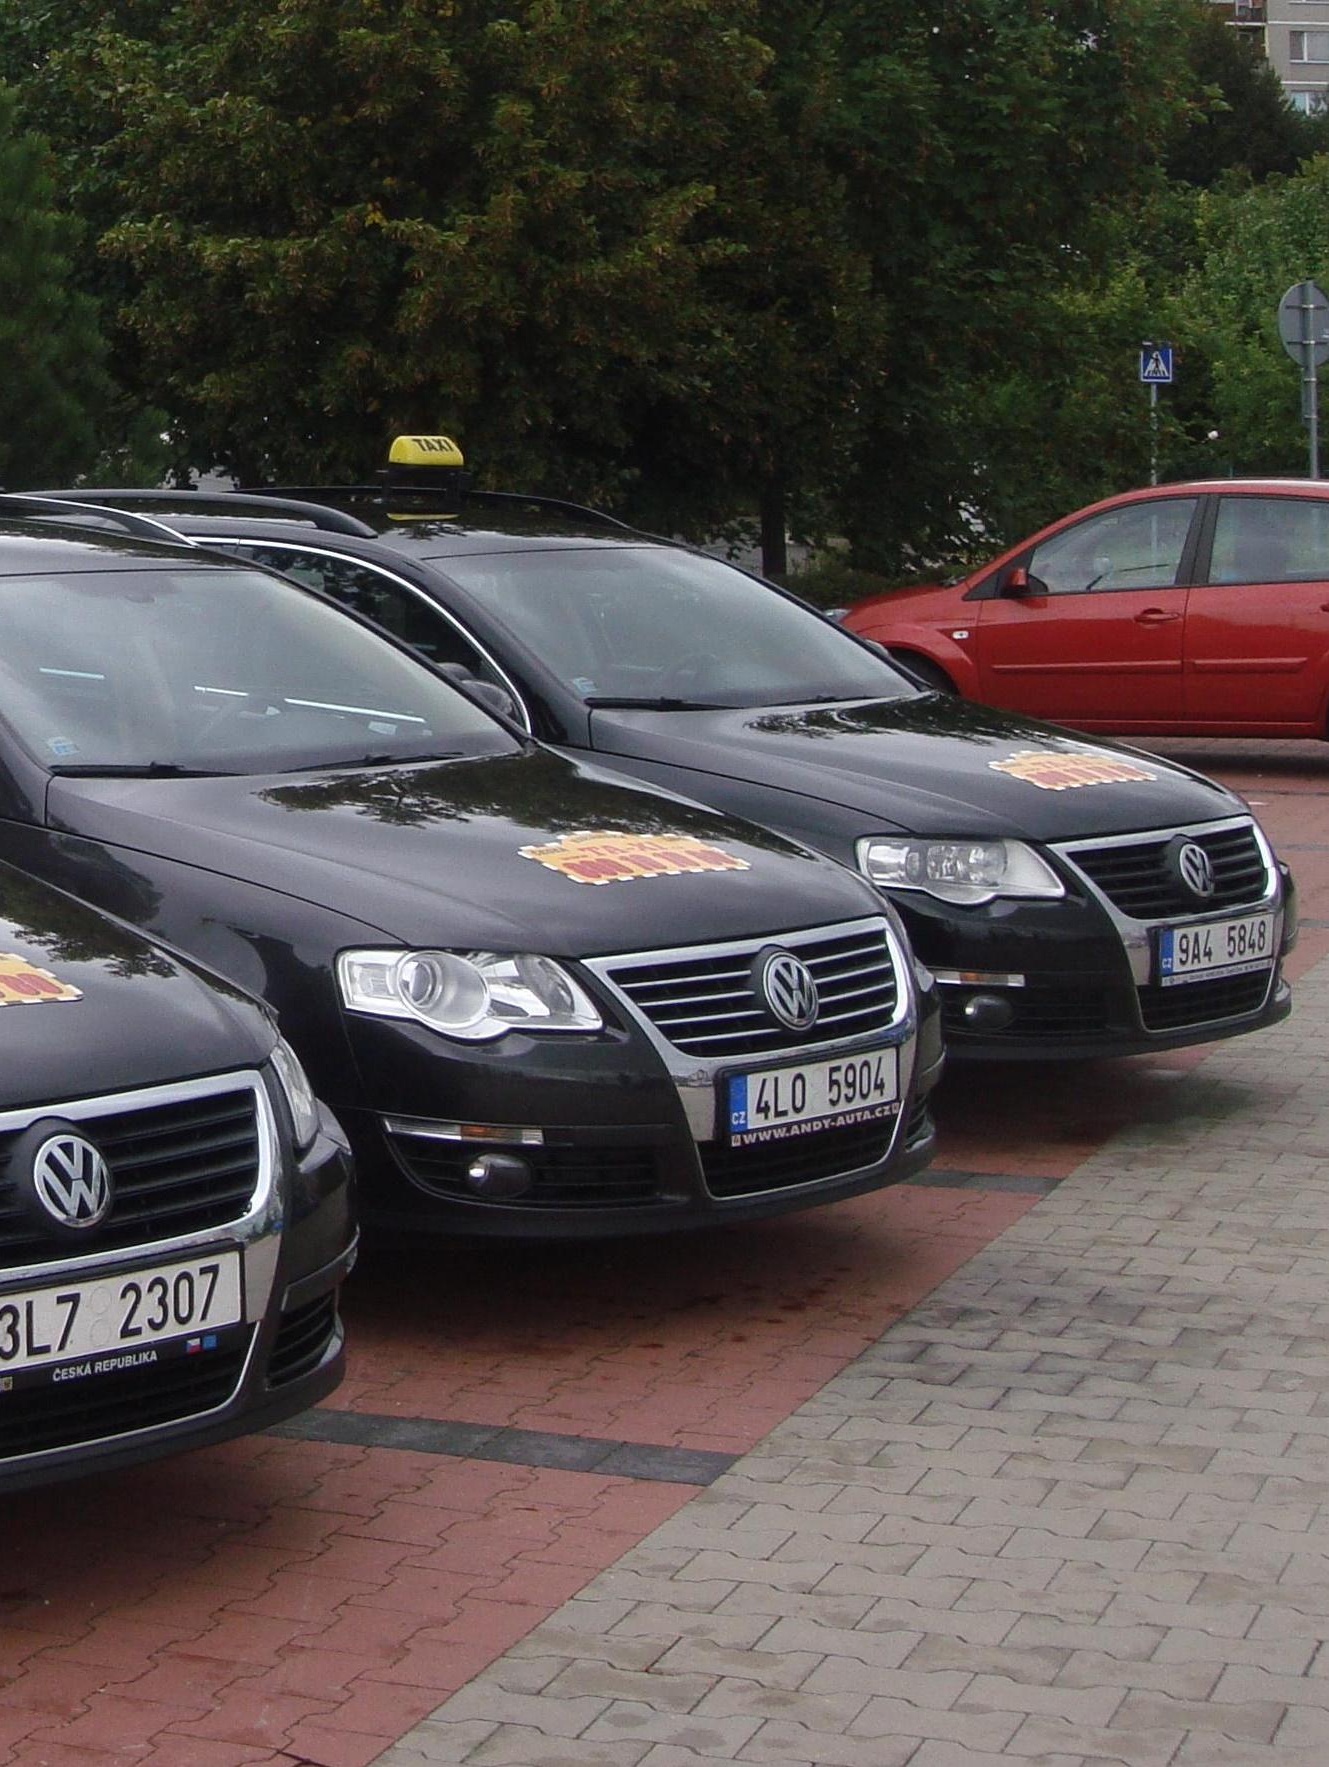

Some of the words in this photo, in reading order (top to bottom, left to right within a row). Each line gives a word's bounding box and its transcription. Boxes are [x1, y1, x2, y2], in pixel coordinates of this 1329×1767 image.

[411, 438, 455, 452] TAXI
[1178, 928, 1213, 966] 9A4
[1226, 919, 1266, 958] 5848
[1161, 957, 1172, 969] CZ
[828, 1056, 885, 1107] 5904
[732, 1110, 746, 1125] CZ
[742, 1106, 892, 1145] WWW.ANDY-AUTA.CZ
[119, 1263, 220, 1340] 2307
[52, 1362, 93, 1383] ČESKÁ
[94, 1349, 158, 1375] REPUBLIKA
